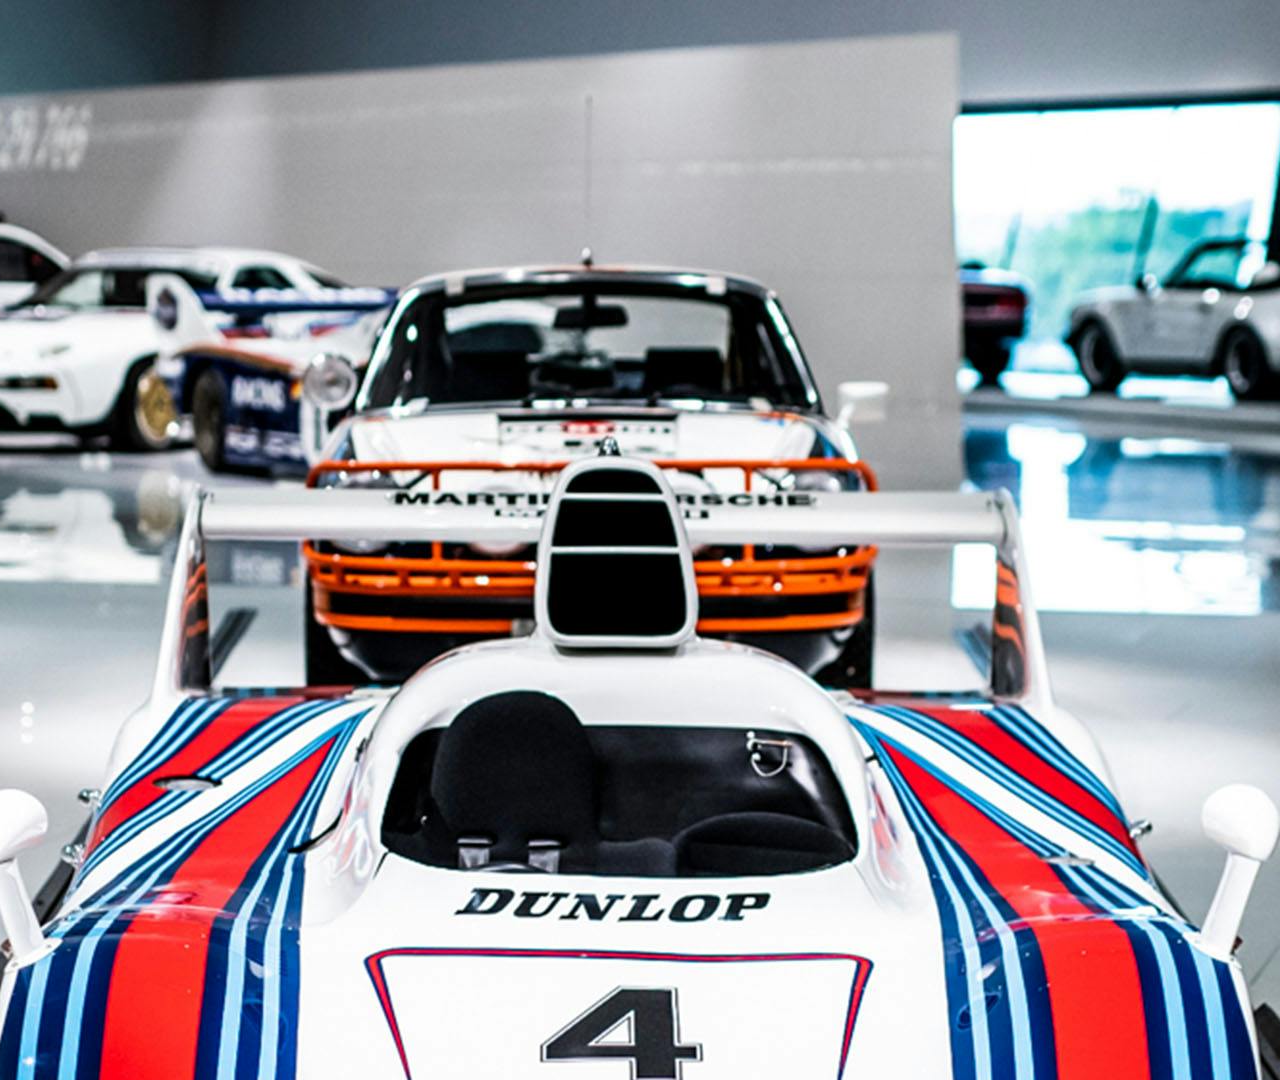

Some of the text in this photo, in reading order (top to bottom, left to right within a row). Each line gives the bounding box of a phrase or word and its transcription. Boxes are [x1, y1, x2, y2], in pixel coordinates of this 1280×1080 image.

[395, 492, 812, 506] MARTI RSCHE
[453, 887, 771, 923] DUNLOP
